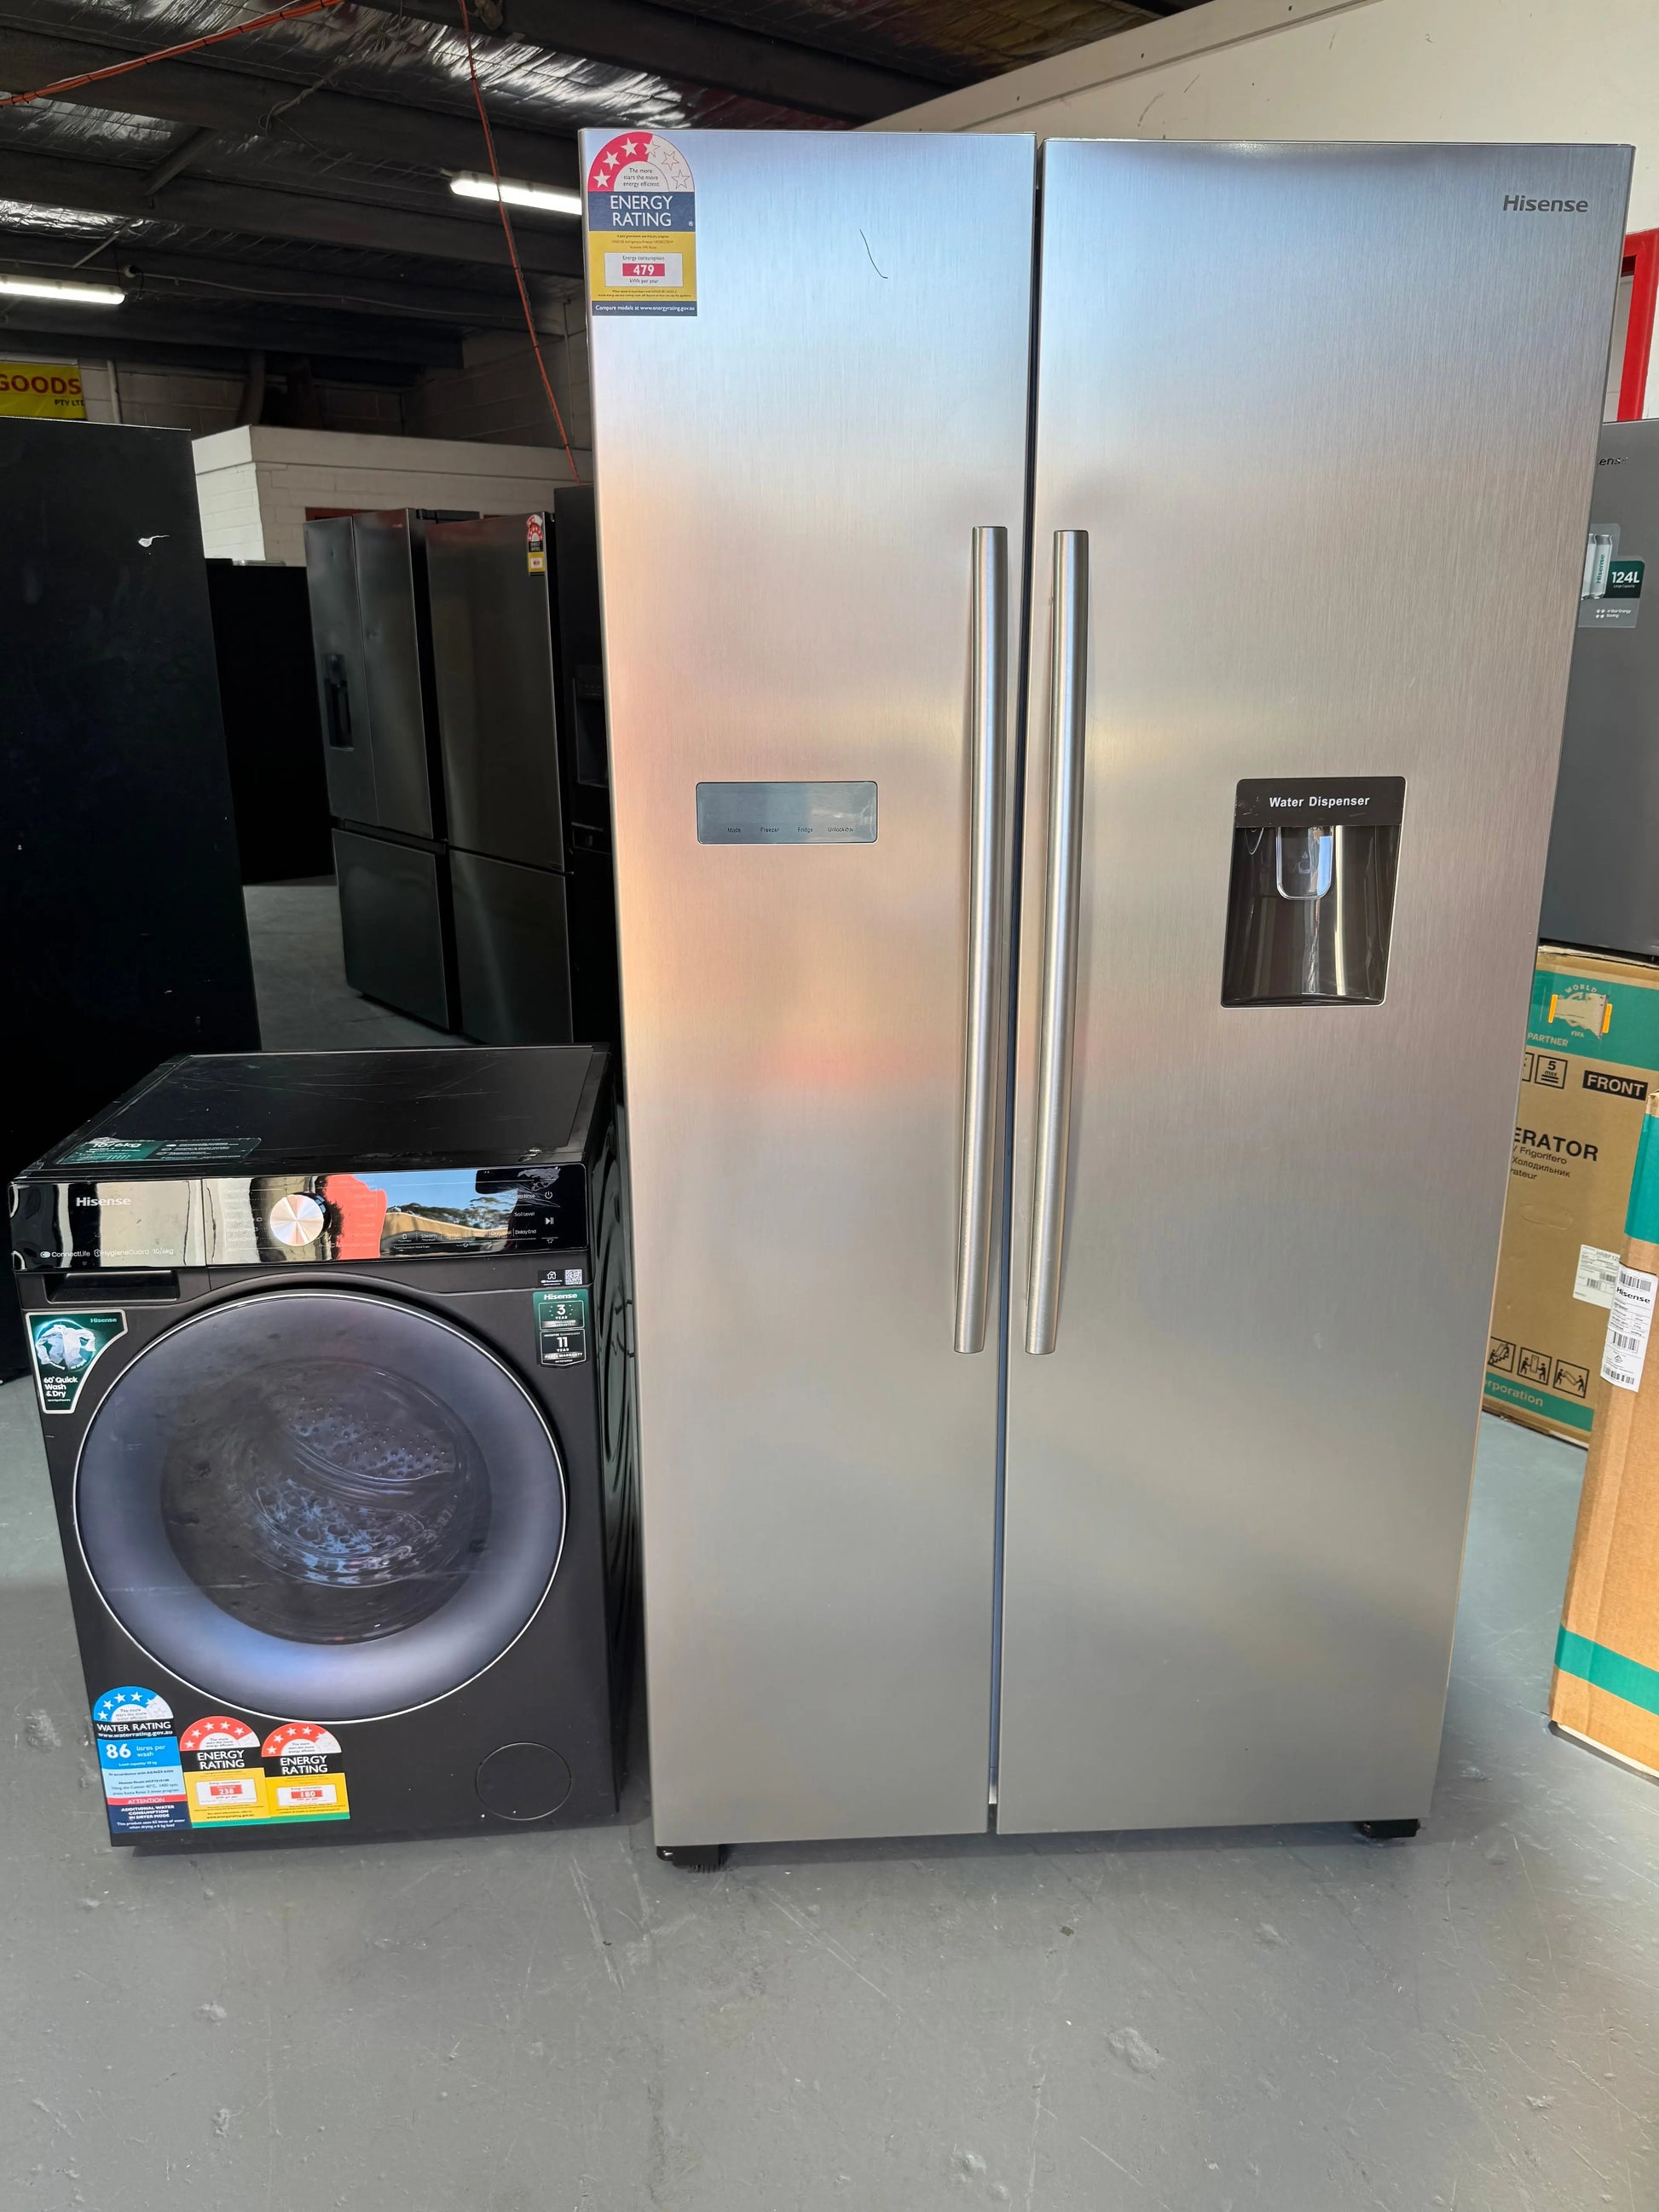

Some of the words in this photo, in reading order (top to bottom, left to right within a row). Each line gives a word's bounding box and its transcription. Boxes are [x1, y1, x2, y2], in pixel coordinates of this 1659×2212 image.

[610, 195, 673, 210] ENERGY
[1503, 194, 1588, 212] Hisense
[612, 212, 672, 227] RATING
[633, 264, 655, 275] 479
[0, 374, 83, 395] GOODS
[1596, 554, 1604, 584] Hisense
[1611, 571, 1640, 583] 124L
[1269, 797, 1304, 807] Water
[1309, 796, 1370, 809] Dispenser
[1564, 984, 1598, 994] WORLD
[1527, 1032, 1569, 1047] PARTNER
[1547, 1060, 1557, 1071] 5
[1587, 1074, 1645, 1097] FRONT
[1519, 1146, 1567, 1164] Frigorifero
[1512, 1156, 1570, 1178] Холодильник
[76, 1197, 131, 1207] Hisense
[101, 1249, 149, 1257] HygieneGuard
[1616, 1287, 1650, 1304] Hisense
[557, 1304, 566, 1315] 3
[557, 1337, 568, 1348] 11
[96, 1724, 130, 1732] WATER
[133, 1721, 171, 1731] RATING
[106, 1743, 132, 1759] 86
[197, 1750, 245, 1761] ENERGY
[199, 1759, 246, 1770] RATING
[280, 1755, 327, 1766] ENERGY
[281, 1764, 328, 1776] RATING
